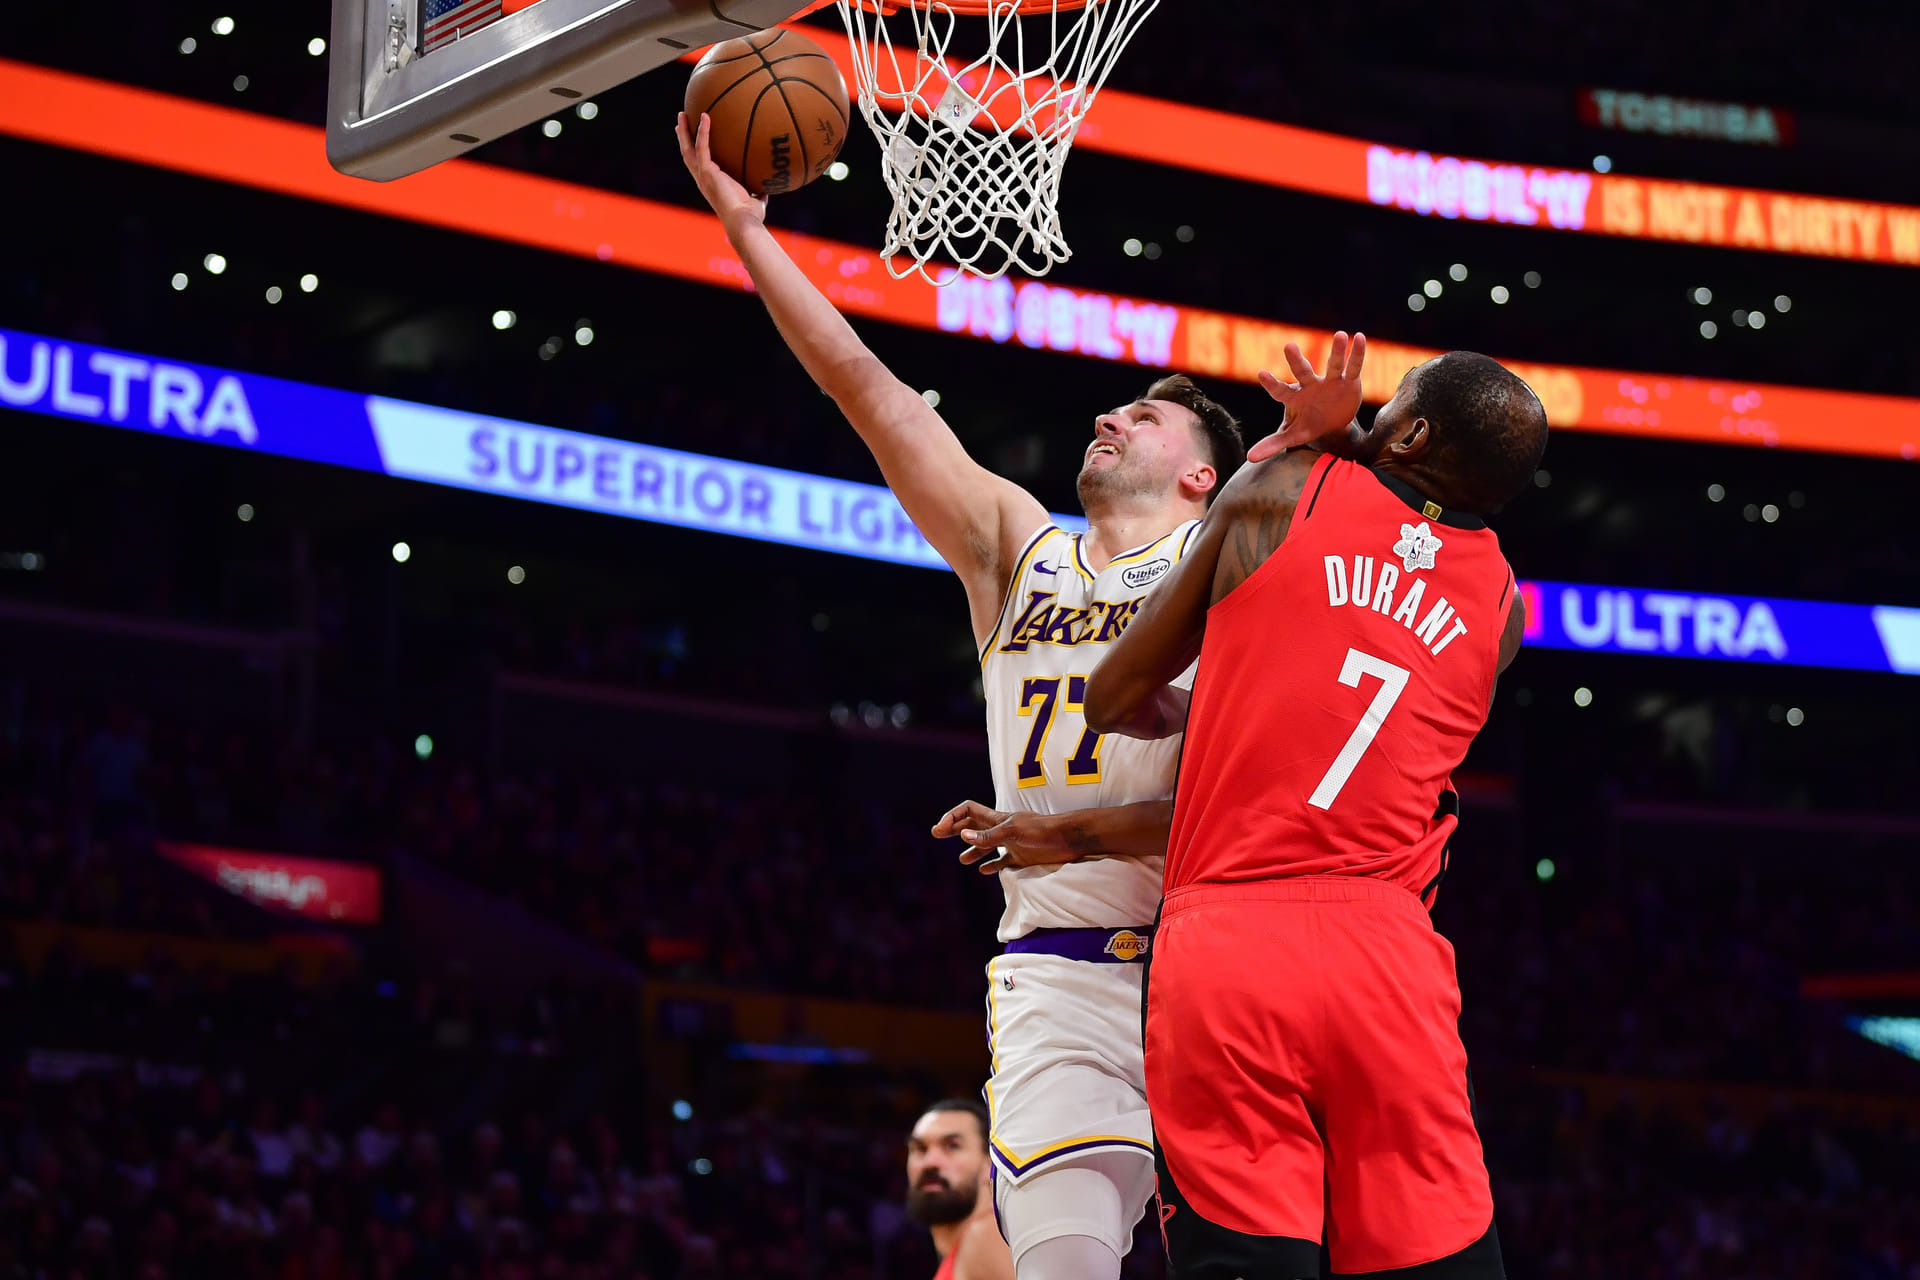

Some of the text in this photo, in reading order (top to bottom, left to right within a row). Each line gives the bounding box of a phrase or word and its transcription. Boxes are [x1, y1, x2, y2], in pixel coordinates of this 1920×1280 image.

[1593, 90, 1778, 145] TOSHIBA
[1602, 178, 1643, 236] IS
[1648, 182, 1729, 245] NOT
[1734, 192, 1768, 249] A
[1770, 195, 1880, 260] DIRTY
[1186, 314, 1229, 376] IS
[0, 334, 258, 446] ULTRA
[467, 428, 925, 547] SUPERIOR LIGH
[1127, 564, 1168, 580] bibigo
[1324, 554, 1468, 656] DURANT
[1560, 587, 1788, 660] ULTRA
[1016, 674, 1106, 789] 77
[1308, 647, 1411, 811] 7
[1106, 937, 1147, 952] LAKERS
